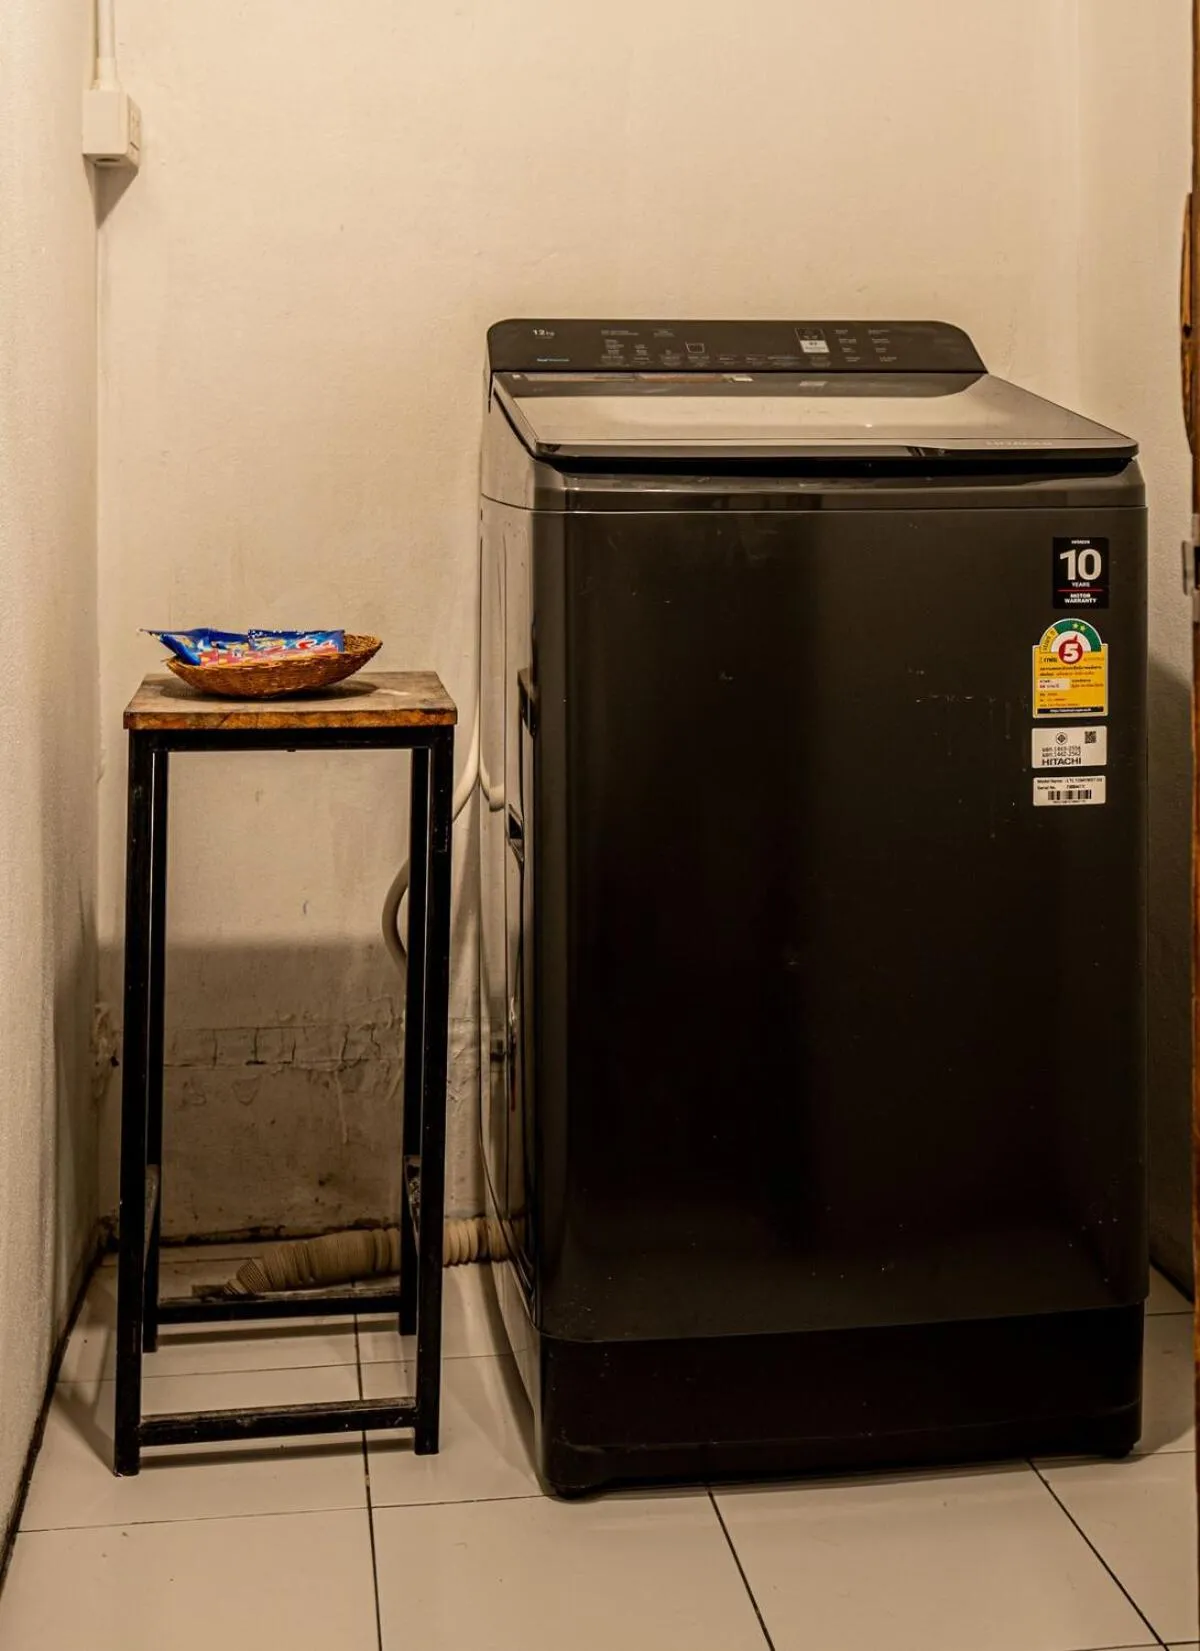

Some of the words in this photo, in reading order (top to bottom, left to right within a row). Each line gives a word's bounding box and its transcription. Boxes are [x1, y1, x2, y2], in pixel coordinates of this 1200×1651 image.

[1060, 548, 1102, 581] 10
[1063, 643, 1079, 663] 5
[1041, 757, 1082, 766] HITACHI
